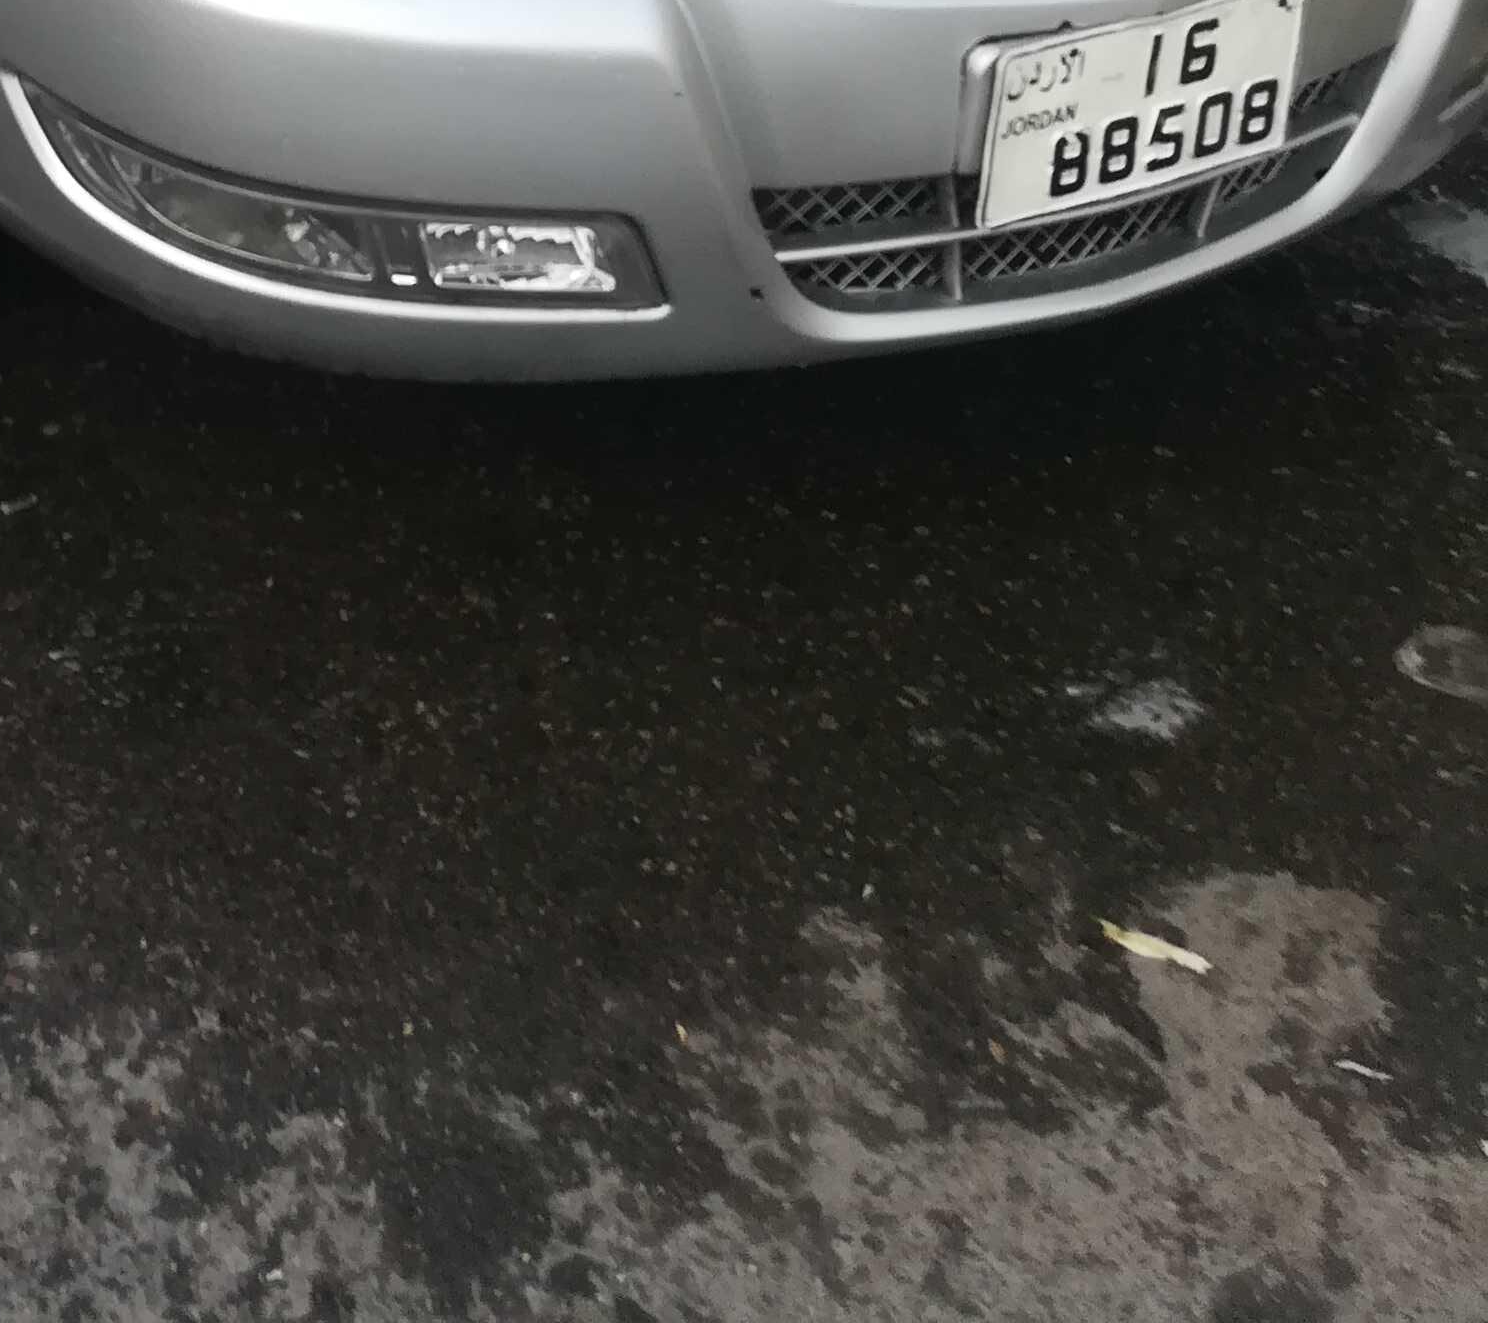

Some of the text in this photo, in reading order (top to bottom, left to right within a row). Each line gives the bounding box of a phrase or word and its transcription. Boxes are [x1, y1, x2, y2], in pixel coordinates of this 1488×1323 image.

[1144, 18, 1220, 98] 16
[1001, 103, 1080, 140] JORDAN
[1049, 78, 1280, 198] 88508
